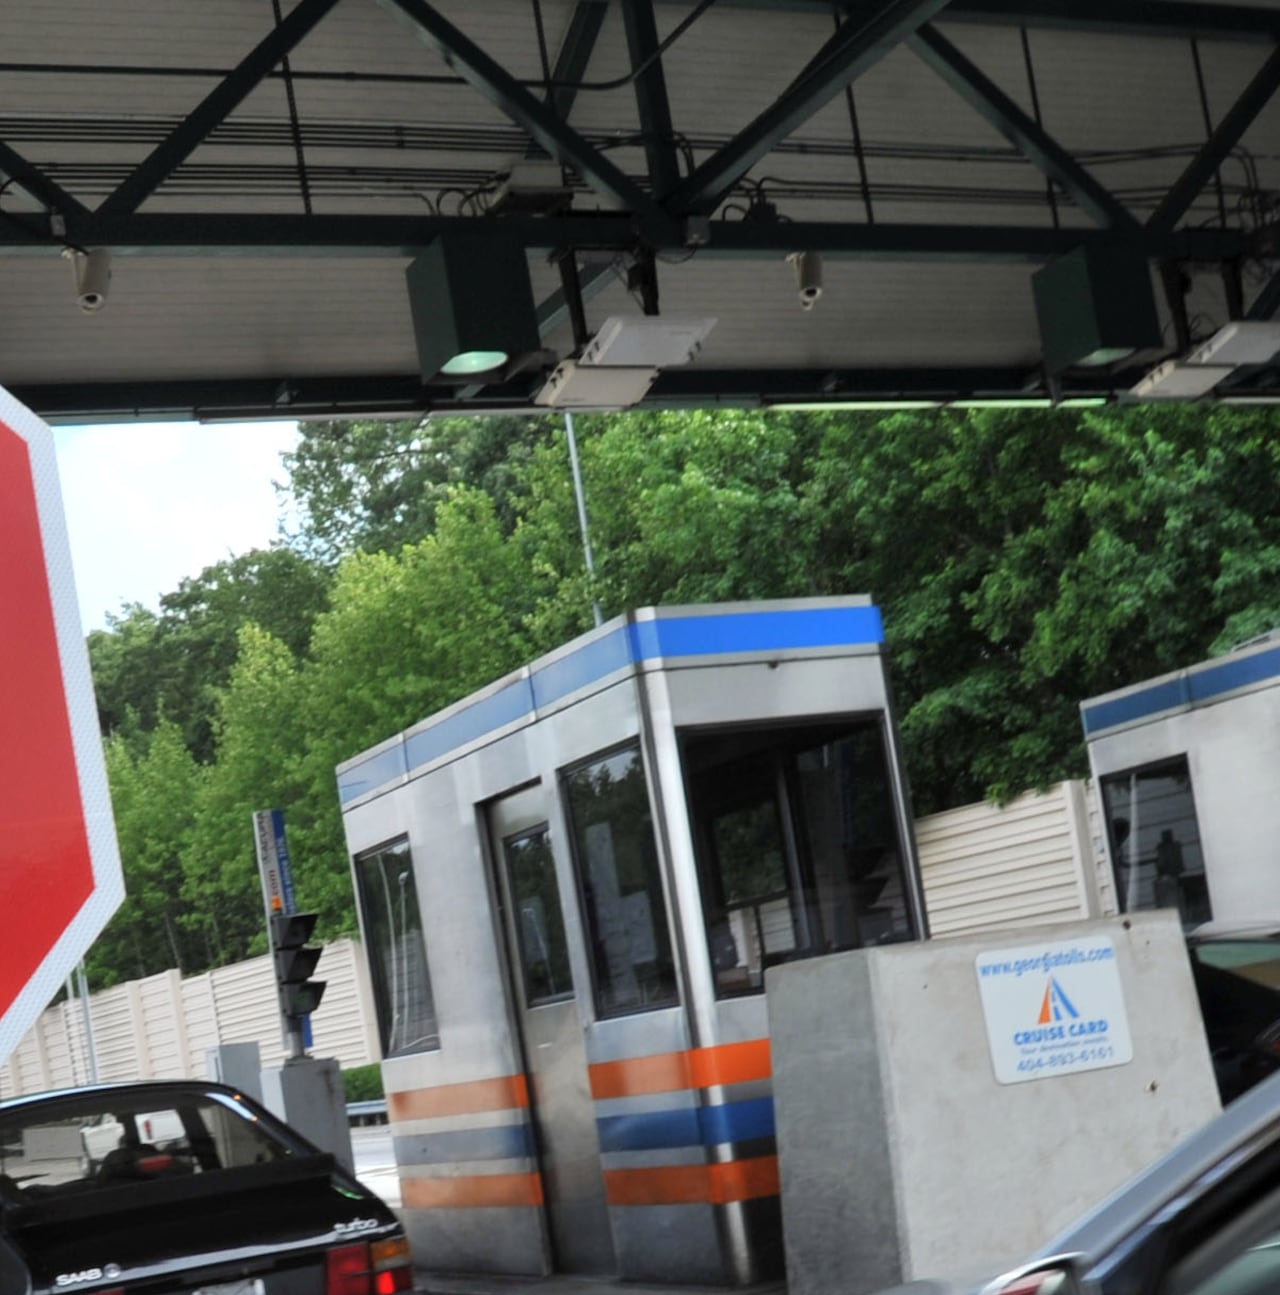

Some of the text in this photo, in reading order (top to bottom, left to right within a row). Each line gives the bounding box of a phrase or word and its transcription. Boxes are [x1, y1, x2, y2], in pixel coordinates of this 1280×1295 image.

[1013, 1019, 1109, 1046] CRUISE CARD
[333, 1217, 379, 1234] turbo
[55, 1268, 103, 1287] SAAB
